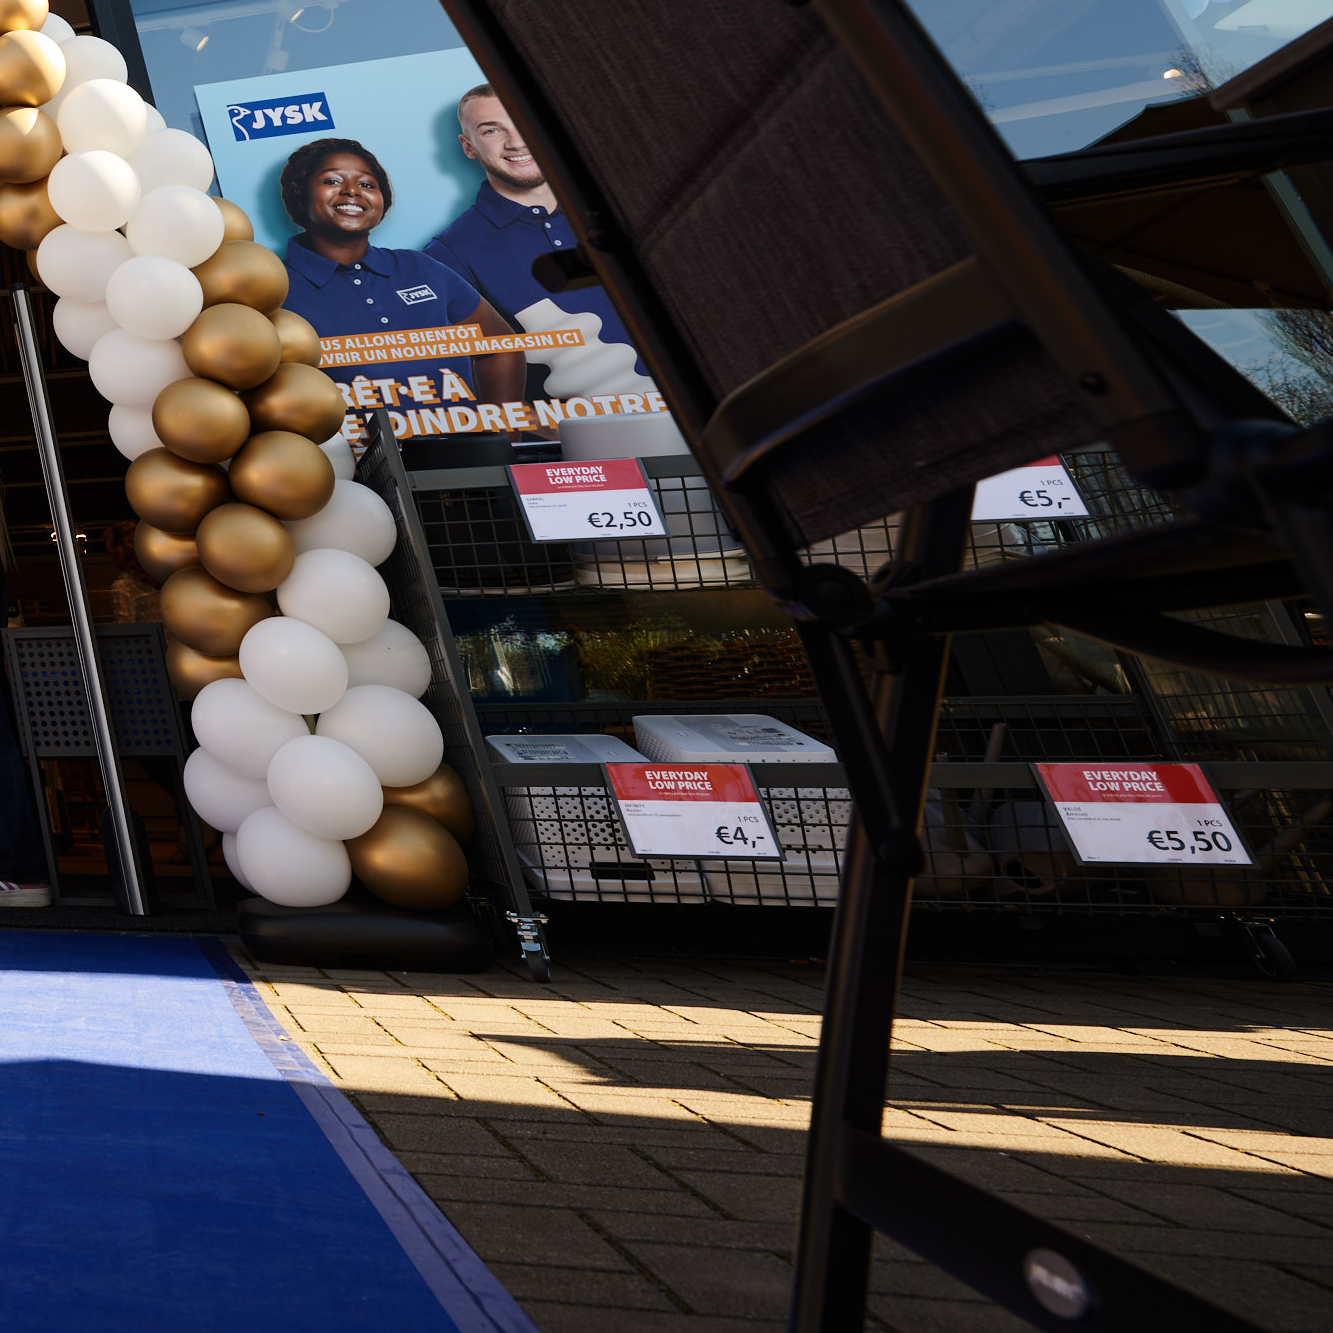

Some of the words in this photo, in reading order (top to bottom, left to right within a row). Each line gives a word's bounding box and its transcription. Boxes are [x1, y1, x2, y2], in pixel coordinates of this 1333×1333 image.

[252, 101, 328, 130] JYSK
[319, 339, 342, 351] US
[345, 332, 406, 350] ALLONS
[409, 325, 478, 344] BIENTÔT
[319, 351, 362, 366] VRIR
[364, 348, 388, 363] UN
[391, 341, 471, 359] NOUVEAU
[475, 335, 554, 352] MAGASIN
[556, 331, 580, 345] ICI
[439, 368, 470, 400] À
[341, 401, 530, 440] EOINDRE
[545, 465, 603, 477] EVERYDAY
[548, 476, 575, 485] LOW
[575, 474, 607, 484] PRICE
[1018, 490, 1071, 509] €5,-
[587, 510, 652, 530] €2,50
[644, 770, 709, 781] EVERYDAY
[1083, 770, 1158, 781] EVERYDAY
[648, 780, 677, 790] LOW
[678, 781, 713, 791] PRICE
[1088, 781, 1123, 791] LOW
[1124, 781, 1165, 792] PRICE
[1204, 819, 1223, 827] PCS
[715, 826, 765, 849] €4,-
[1147, 830, 1232, 854] €5,50
